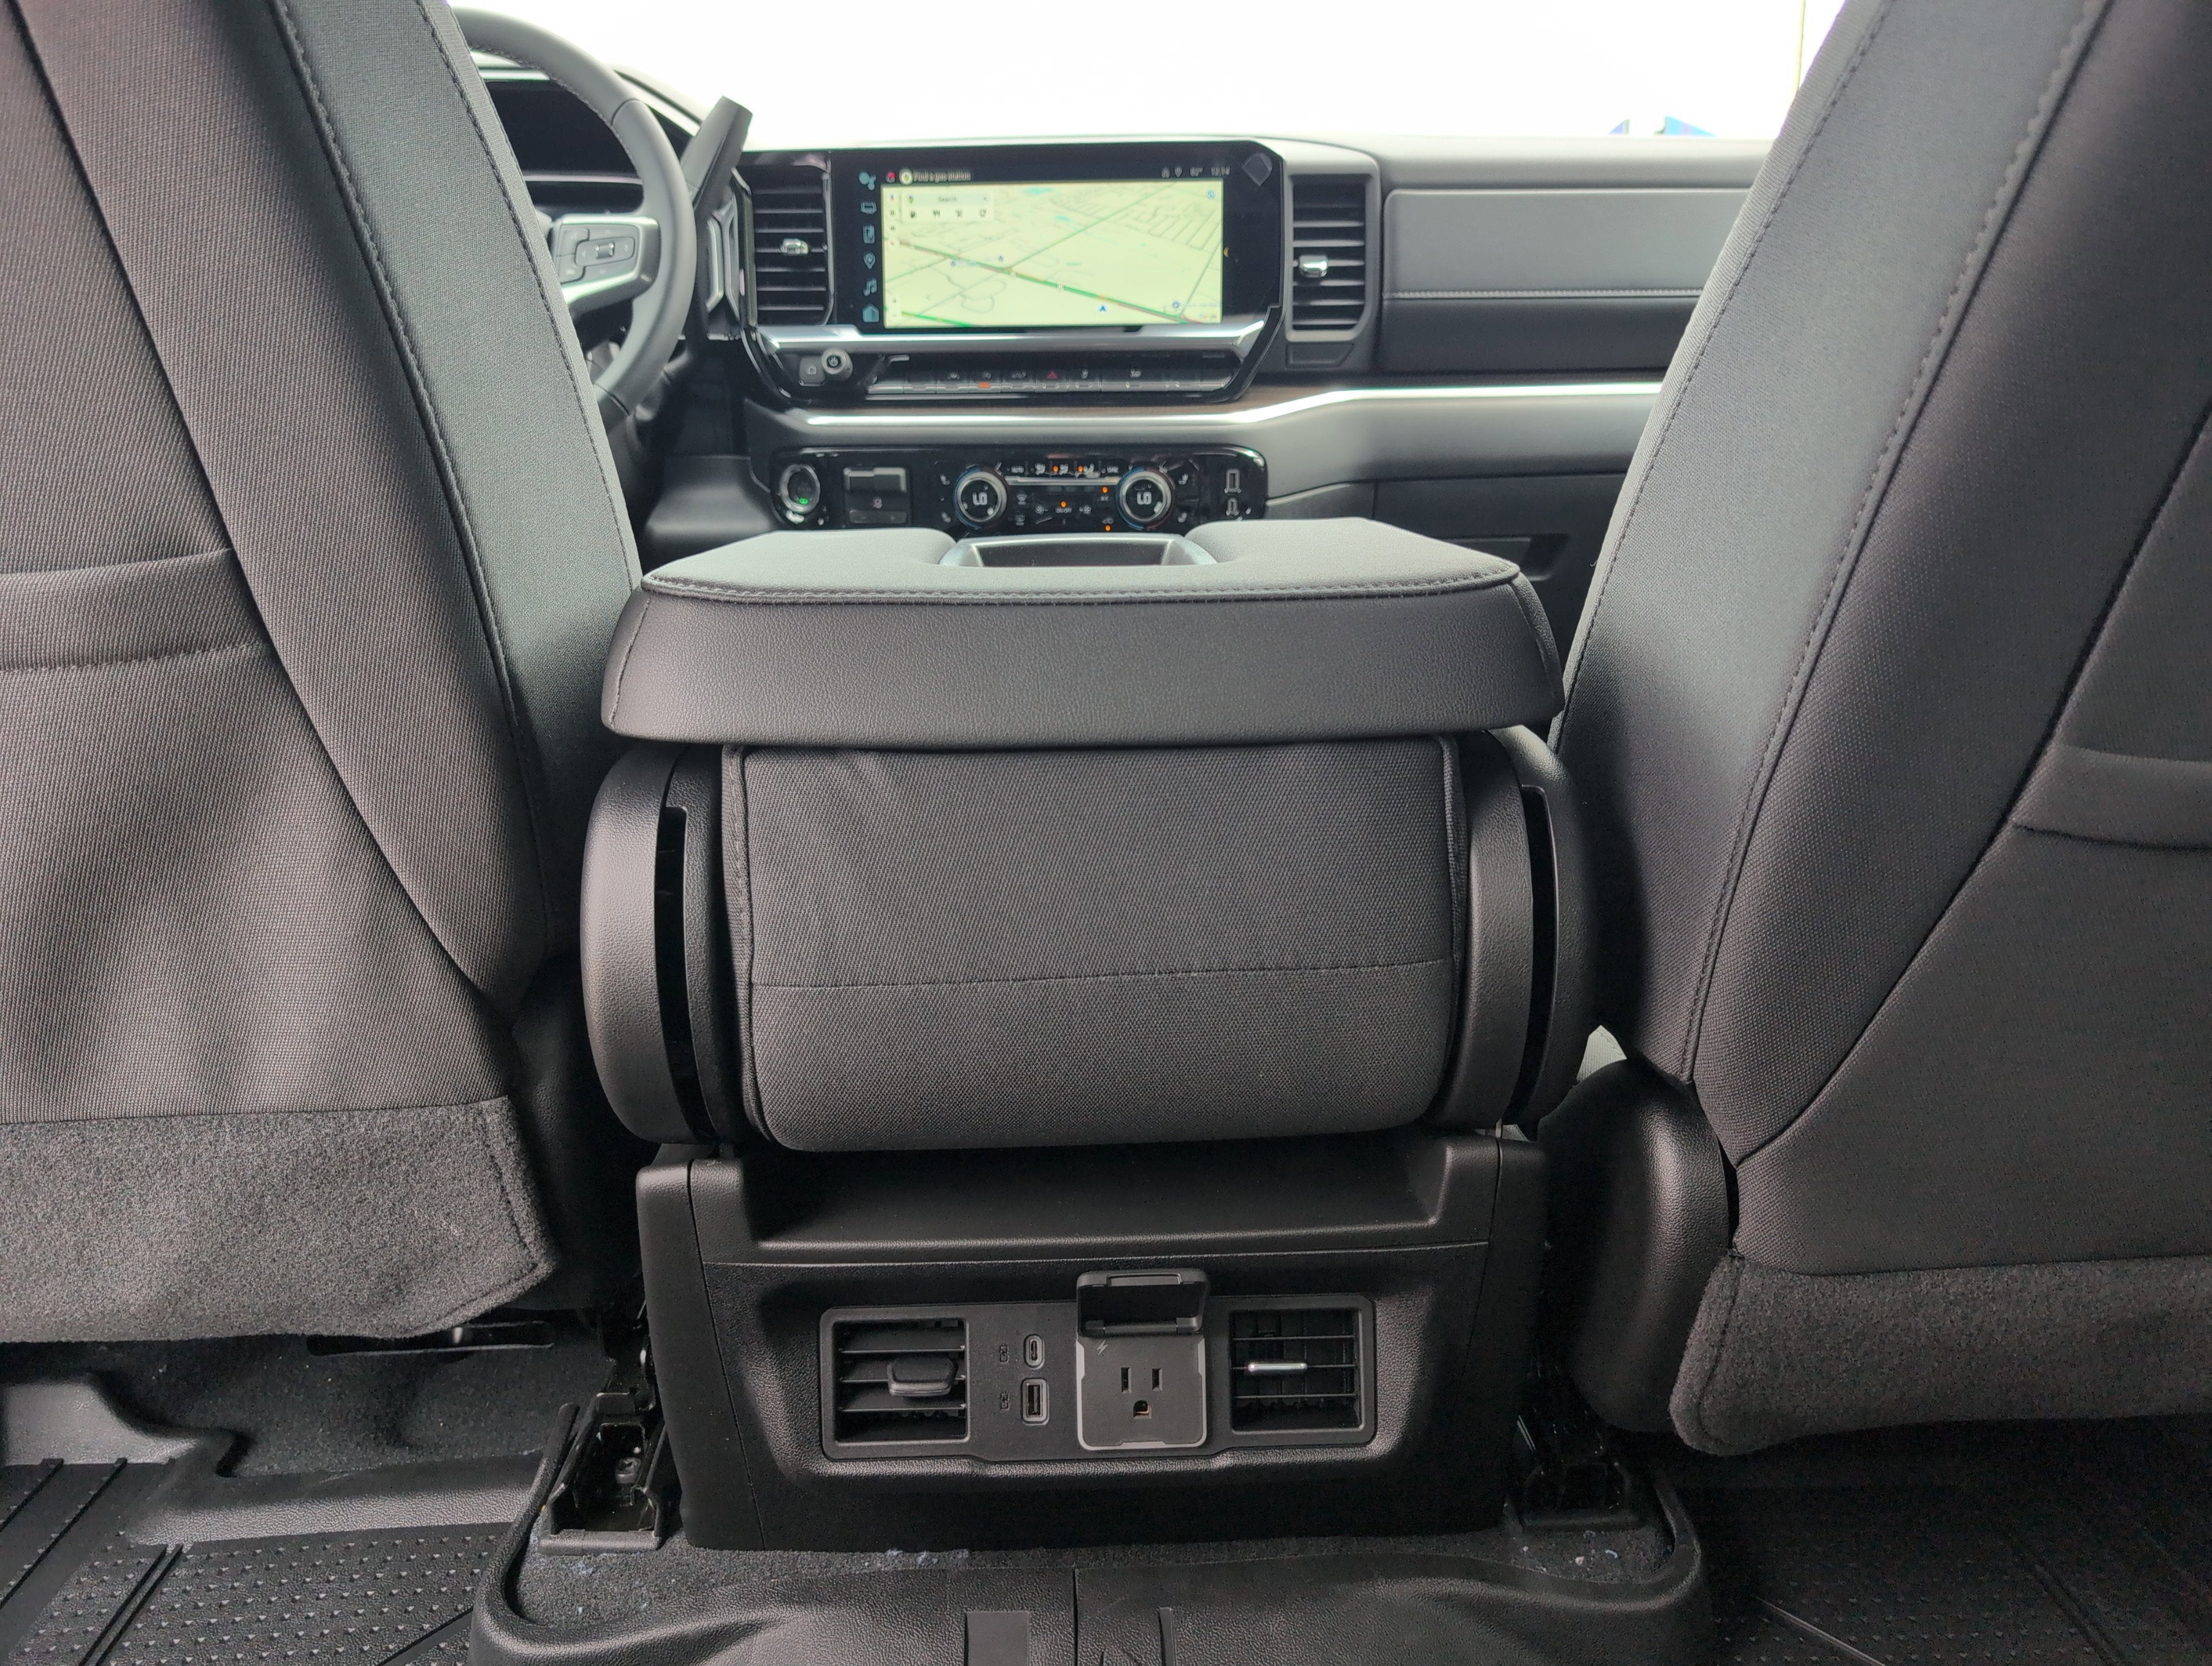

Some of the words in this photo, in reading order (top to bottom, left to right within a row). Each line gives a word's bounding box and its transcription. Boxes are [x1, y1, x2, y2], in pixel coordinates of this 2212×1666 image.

[914, 171, 928, 182] Find
[935, 173, 947, 183] gas
[948, 171, 971, 181] station
[973, 492, 987, 505] LO
[1137, 492, 1152, 505] LO
